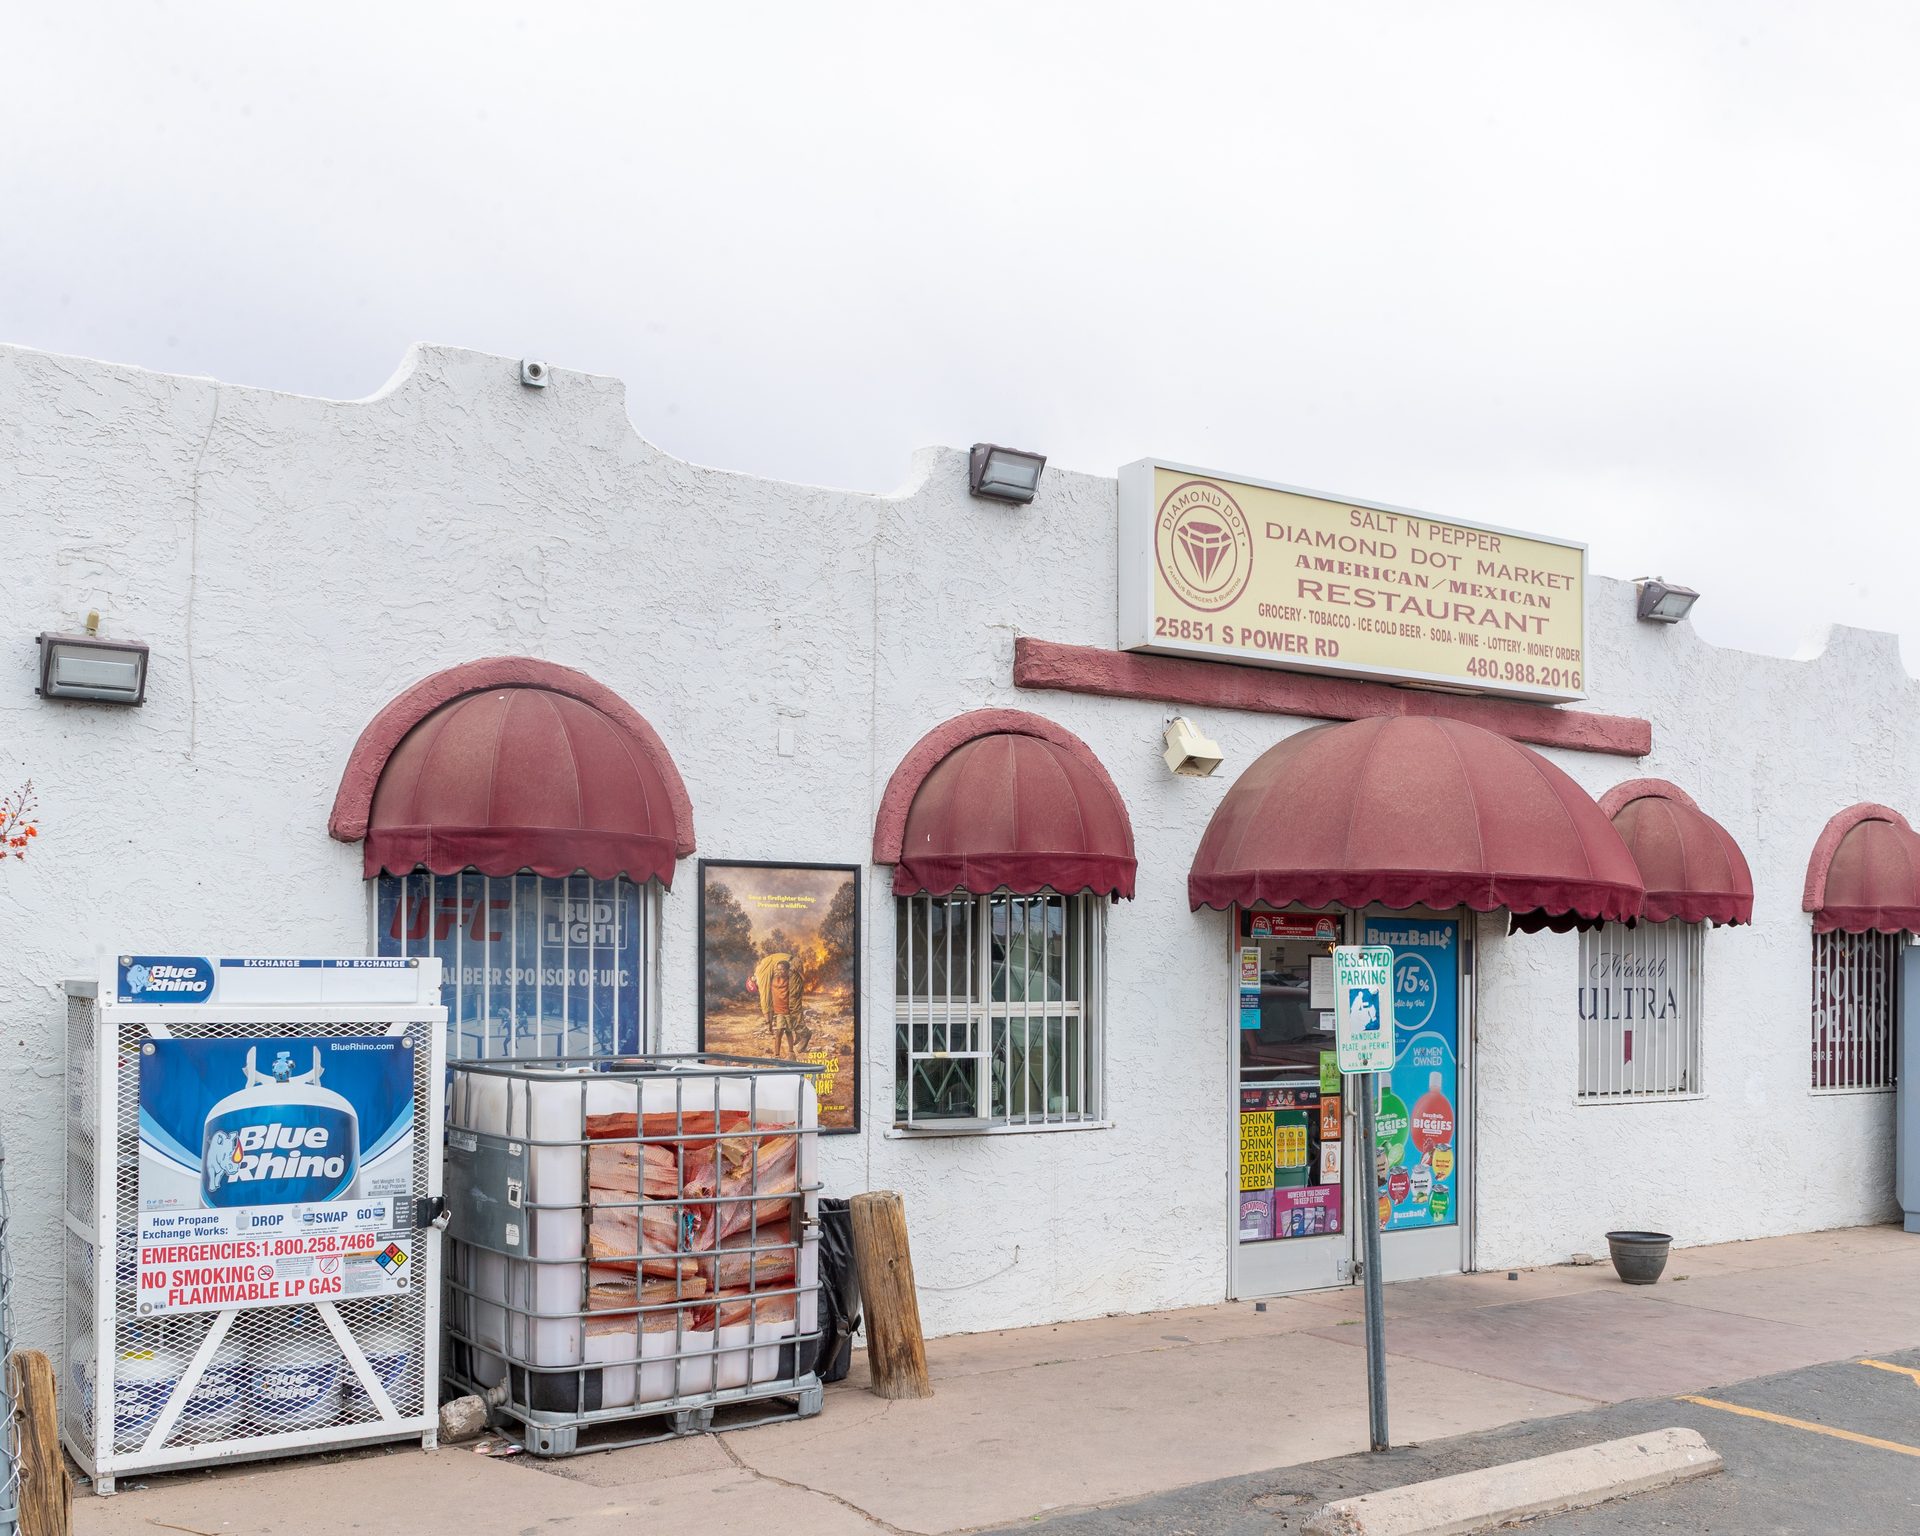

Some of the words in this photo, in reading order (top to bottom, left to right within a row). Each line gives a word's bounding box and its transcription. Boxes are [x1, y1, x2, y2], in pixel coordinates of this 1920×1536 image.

[1162, 491, 1221, 530] DIAMOND
[1223, 505, 1246, 538] DOT
[1350, 509, 1398, 533] SALT
[1407, 520, 1420, 538] N
[1429, 524, 1501, 553] PEPPER
[1266, 522, 1397, 559] DIAMOND
[1411, 548, 1462, 571] DOT
[1477, 560, 1574, 591] MARKET
[1298, 578, 1550, 635] RESTAURANT
[1155, 616, 1214, 642] 25851
[1222, 625, 1234, 645] S
[1241, 627, 1309, 653] POWER
[1315, 637, 1339, 658] RD
[1258, 602, 1302, 622] GROCERY
[1309, 610, 1351, 629] TOBACCO
[1358, 617, 1372, 632] ICE
[1375, 620, 1397, 635] COLD
[1400, 623, 1421, 639] BEER
[1430, 628, 1452, 643] SODA
[1458, 632, 1479, 647] WINE
[1488, 636, 1522, 654] LOTTERY
[1527, 642, 1554, 659] MONEY
[1555, 647, 1580, 662] ORDER
[1466, 656, 1581, 690] 480.988.2016
[390, 896, 511, 942] UFC
[558, 903, 612, 924] BUD
[548, 923, 622, 944] LIGHT
[244, 959, 300, 968] EXCHANGE
[336, 960, 350, 968] NO
[353, 960, 405, 968] EXCHANGE
[152, 965, 197, 979] Blue
[463, 968, 502, 986] BEER
[505, 968, 575, 987] SPONSOR
[579, 969, 597, 987] OF
[1341, 970, 1386, 985] PARKING
[146, 978, 207, 993] Rhino
[1812, 965, 1887, 1006] FOUR
[1579, 987, 1680, 1021] ULTRA
[1812, 1004, 1887, 1042] PEAKS
[1351, 1032, 1381, 1040] HANDICAP
[331, 1043, 394, 1052] BlueRhino.com
[1342, 1043, 1358, 1052] PLATE
[1369, 1041, 1389, 1050] PERMIT
[808, 1051, 828, 1059] STOP
[1357, 1052, 1373, 1060] ONLY
[1413, 1056, 1442, 1066] OWNED
[1240, 1113, 1273, 1125] DRINK
[1323, 1116, 1338, 1129] 21+
[1375, 1118, 1408, 1131] IGGIES
[1413, 1118, 1452, 1131] BIGGIES
[238, 1123, 329, 1150] Blue
[1240, 1125, 1273, 1137] YERBA
[1240, 1138, 1273, 1150] DRINK
[1240, 1150, 1273, 1163] YERBA
[227, 1150, 345, 1183] Rhino
[1240, 1163, 1273, 1175] DRINK
[1240, 1175, 1273, 1188] YERBA
[152, 1217, 175, 1227] How
[178, 1215, 219, 1226] Propane
[252, 1214, 284, 1227] DROP
[315, 1211, 348, 1224] SWAP
[357, 1208, 372, 1220] GO
[142, 1229, 191, 1239] Exchange
[194, 1227, 228, 1236] Works:
[380, 1255, 387, 1263] 2
[397, 1254, 403, 1262] 0
[141, 1271, 167, 1289] NO
[172, 1265, 255, 1287] SMOKING
[168, 1281, 279, 1306] FLAMMABLE
[285, 1279, 305, 1297] LP
[309, 1276, 342, 1295] GAS
